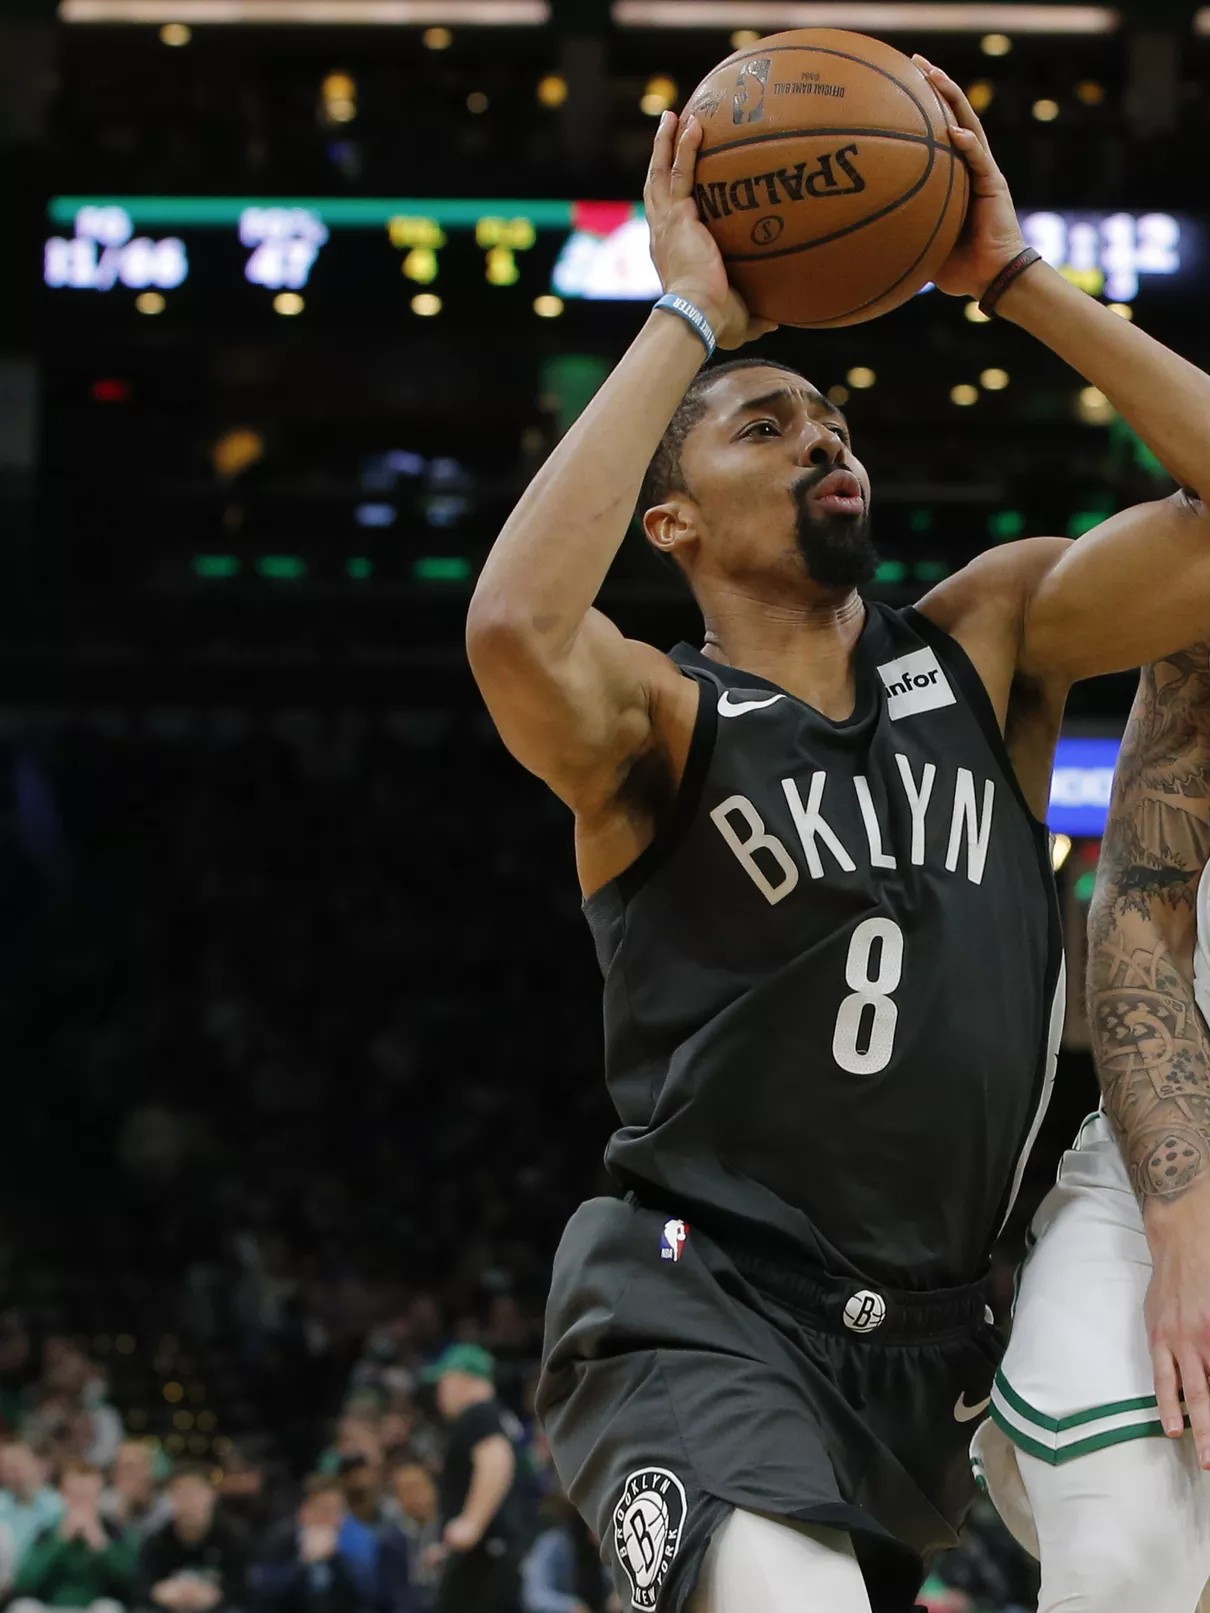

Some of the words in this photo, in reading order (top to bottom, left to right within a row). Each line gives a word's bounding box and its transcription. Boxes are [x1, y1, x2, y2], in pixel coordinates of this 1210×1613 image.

[814, 84, 845, 98] OFFICIAL
[672, 297, 704, 326] WATER
[700, 320, 713, 341] LIKE
[709, 753, 995, 905] BKLYN
[832, 917, 904, 1075] 8
[617, 1474, 671, 1558] BROOKLYN
[636, 1587, 656, 1605] NEW
[657, 1528, 678, 1586] YORK
